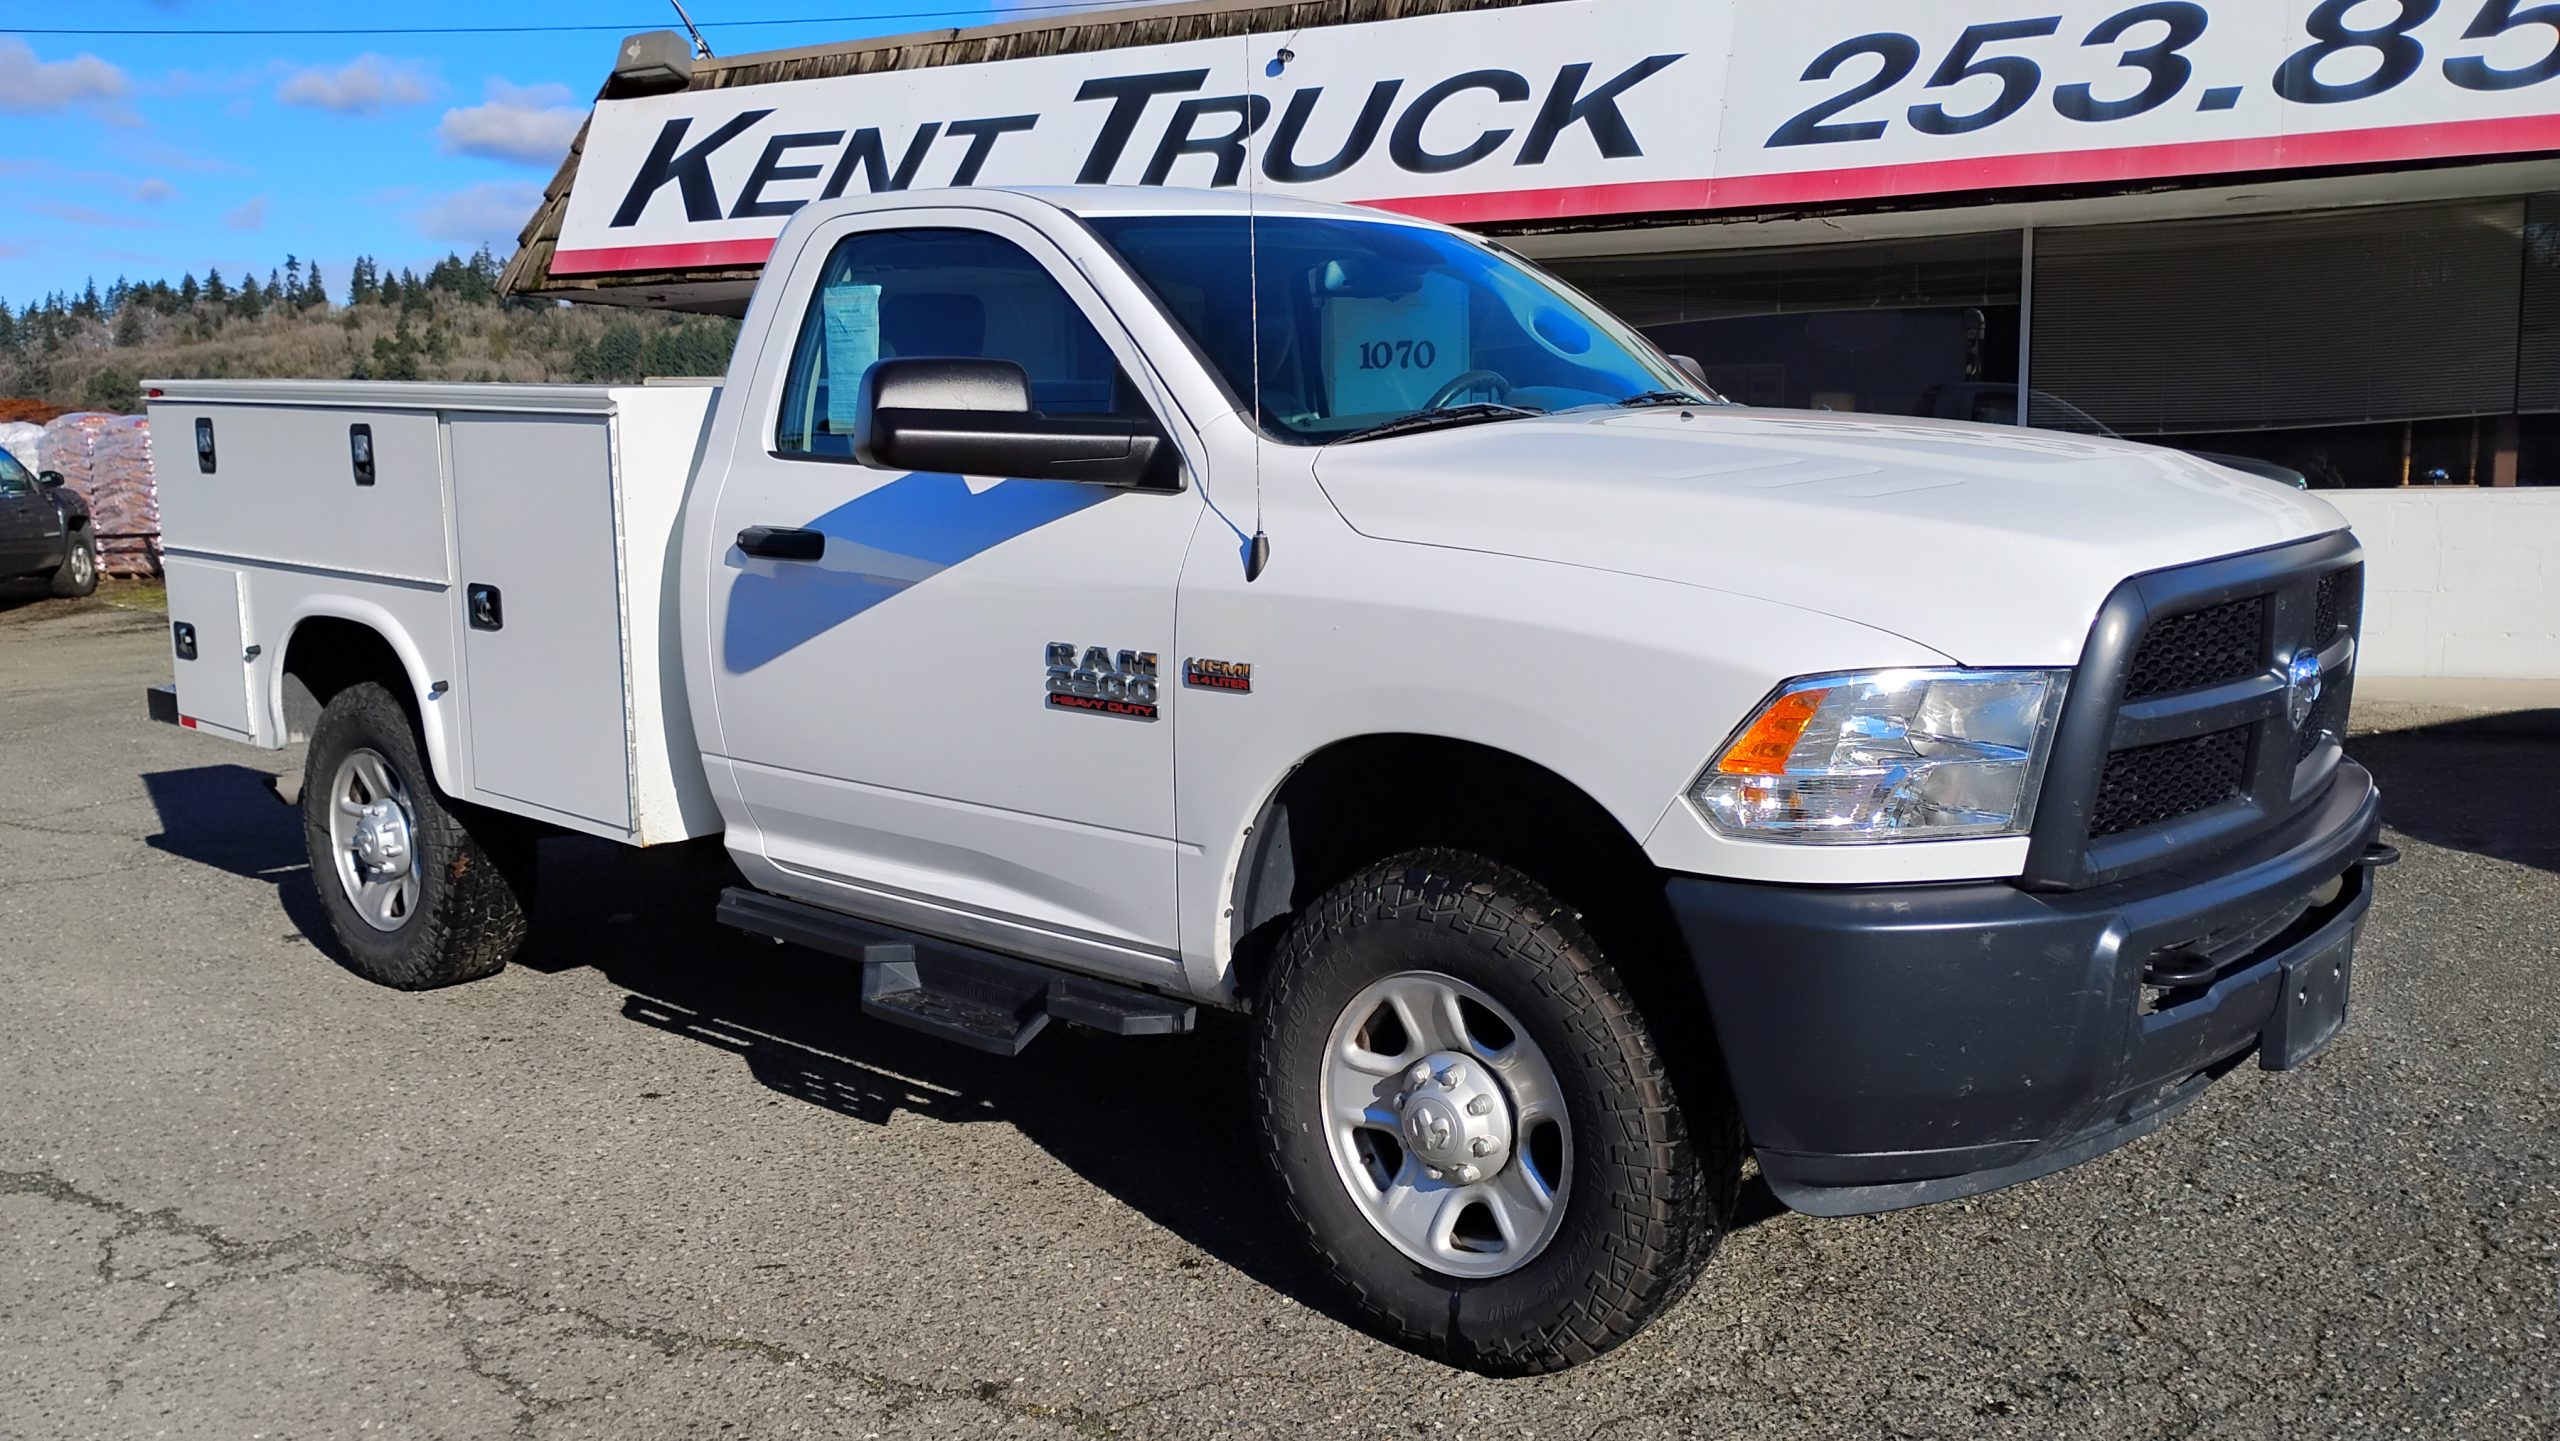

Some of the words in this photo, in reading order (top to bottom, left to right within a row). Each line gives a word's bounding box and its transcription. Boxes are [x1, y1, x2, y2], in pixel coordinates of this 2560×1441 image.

[608, 108, 1041, 228] KENT
[1074, 53, 1688, 189] TRUCK
[1359, 340, 1436, 370] 1070
[1045, 640, 1160, 677] RAM
[1184, 657, 1252, 679] HEMI
[1045, 668, 1160, 704] 2500
[1211, 676, 1249, 690] LITER
[1052, 694, 1105, 709] HEAVY
[1107, 701, 1154, 716] DUTY
